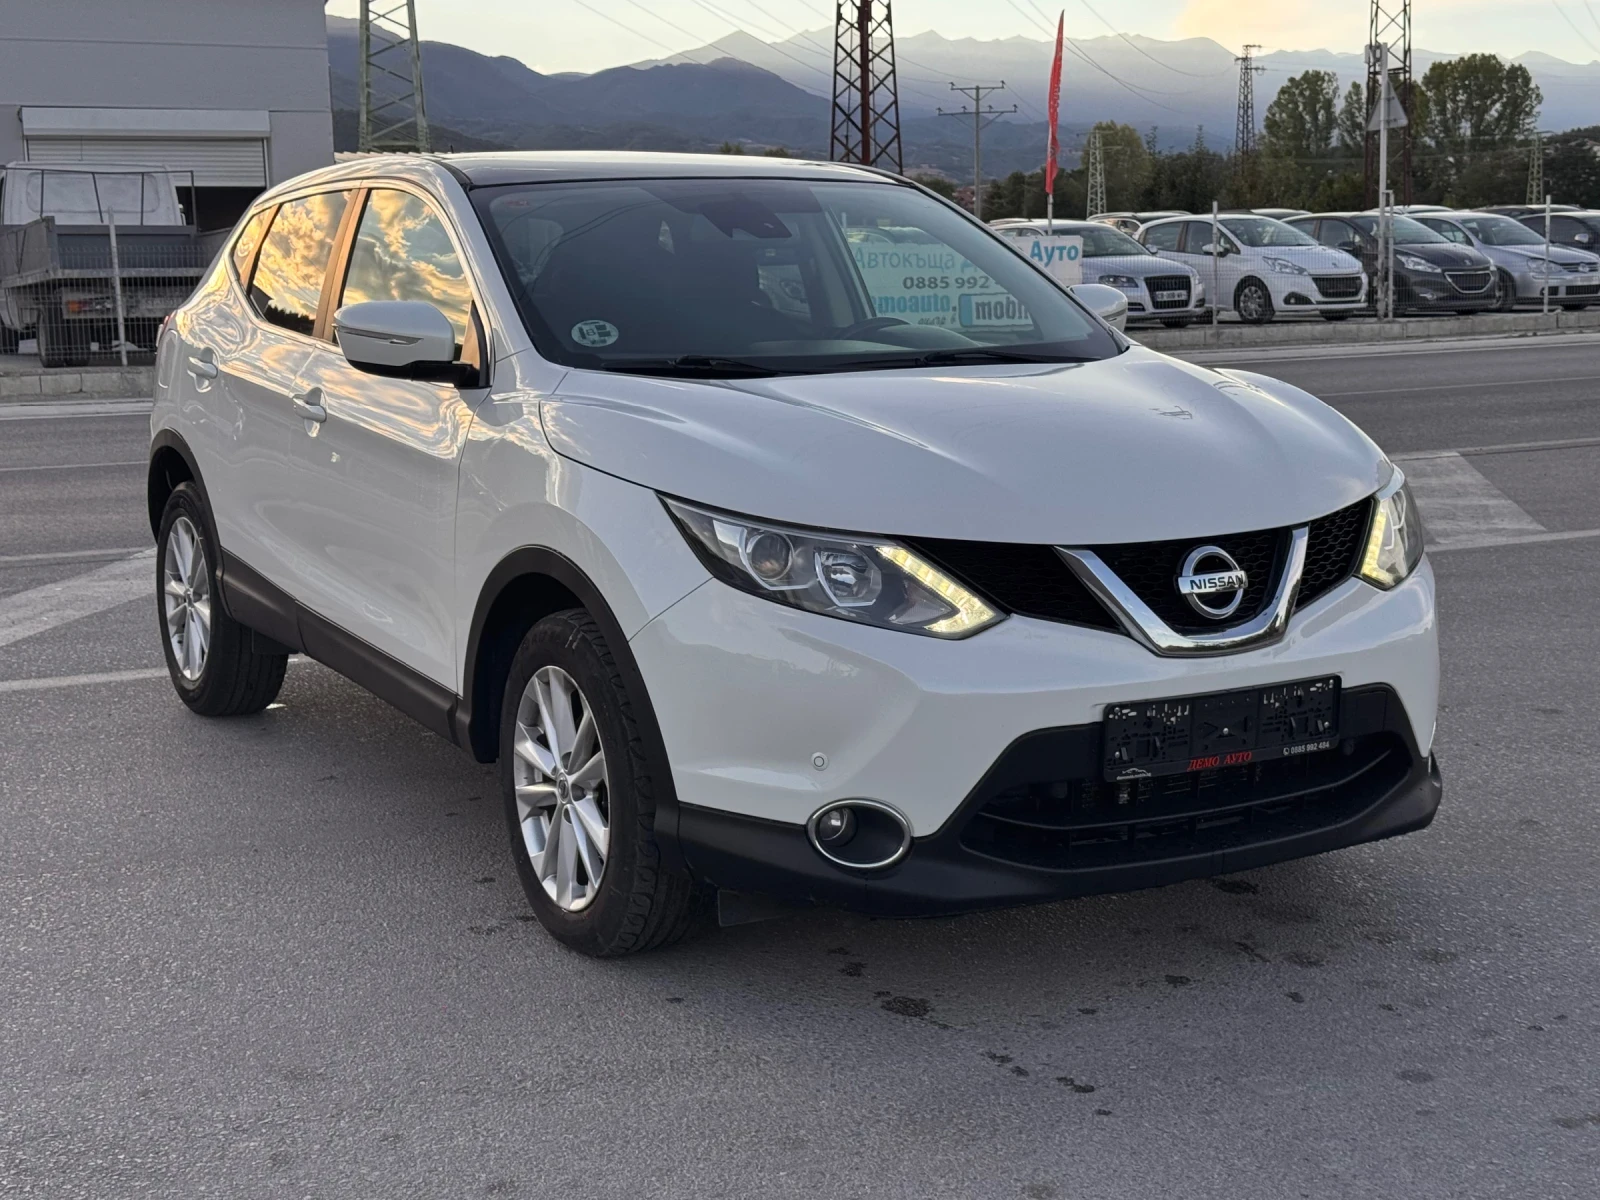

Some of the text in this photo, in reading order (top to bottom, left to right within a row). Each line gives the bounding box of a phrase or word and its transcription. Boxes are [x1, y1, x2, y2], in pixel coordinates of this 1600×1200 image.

[854, 247, 955, 273] Автокъща
[1030, 240, 1079, 268] Ауто
[902, 276, 990, 290] 0885 992
[1189, 574, 1244, 590] NISSAN
[1187, 751, 1253, 772] ДЕМО АУТО
